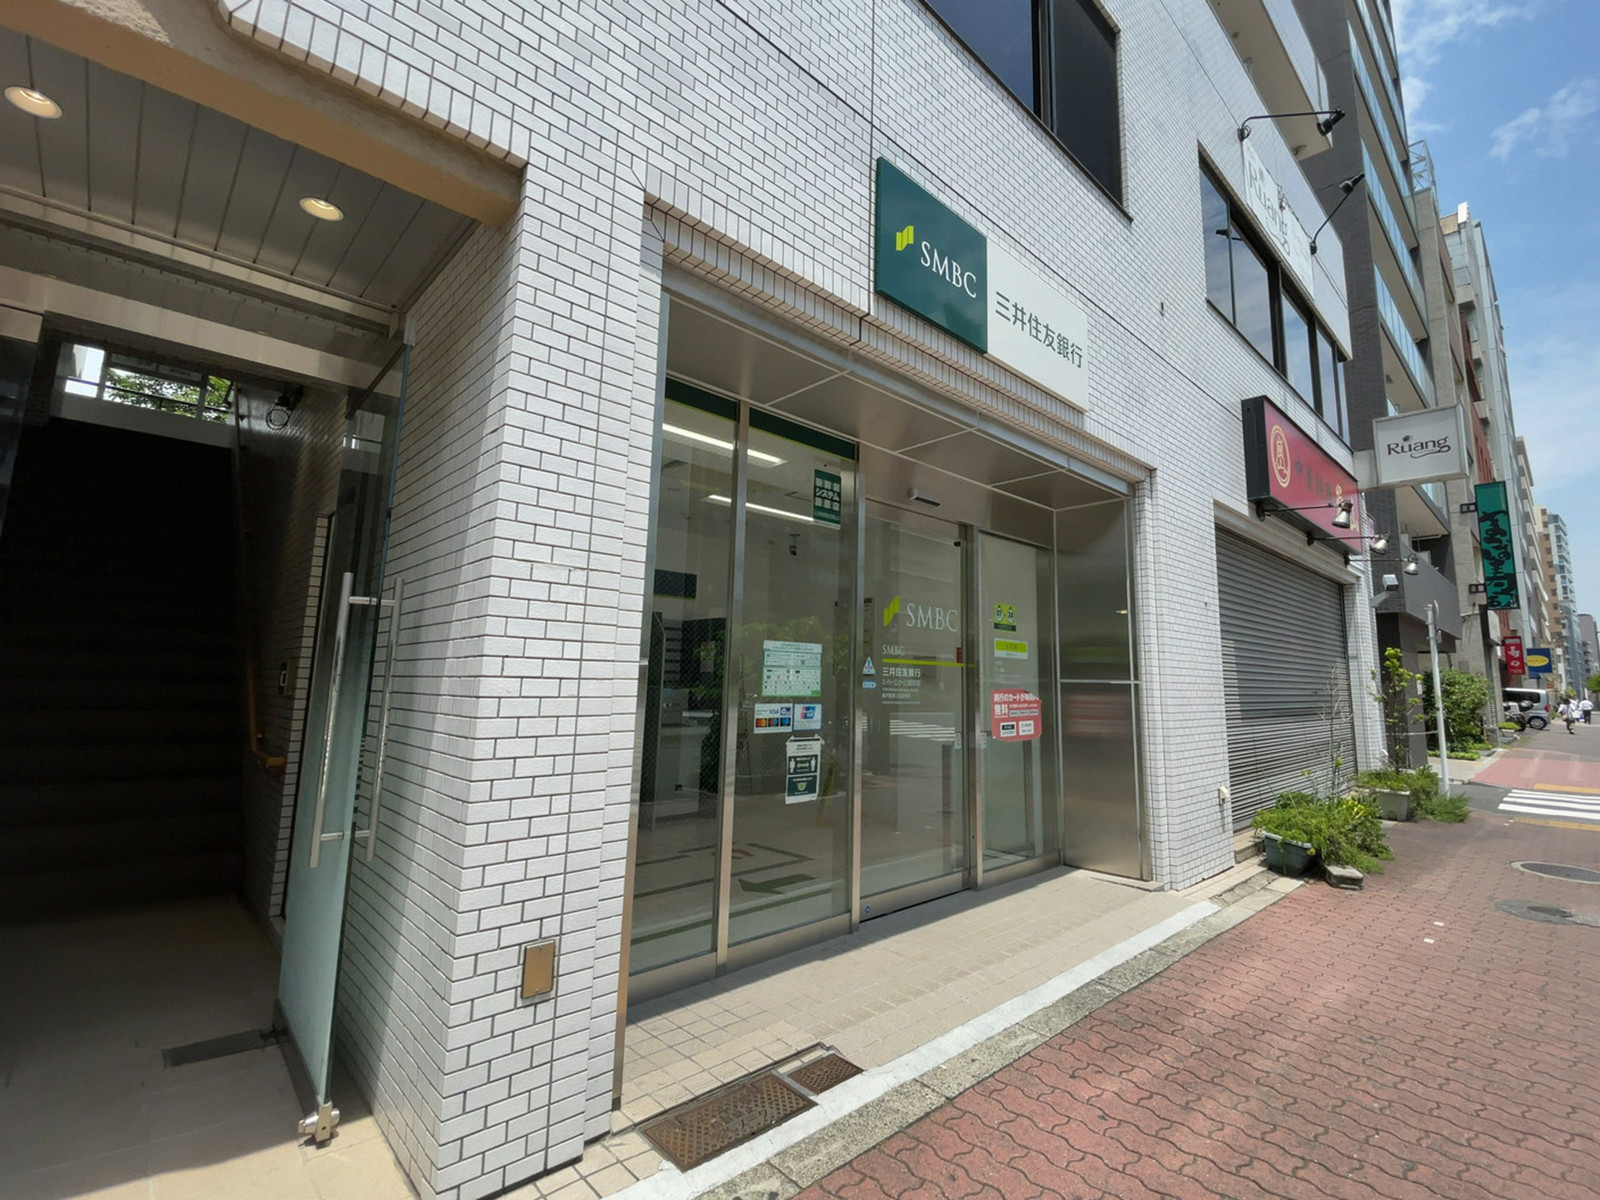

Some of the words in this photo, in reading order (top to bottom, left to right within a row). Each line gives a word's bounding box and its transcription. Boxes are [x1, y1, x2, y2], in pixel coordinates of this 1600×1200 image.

[920, 240, 977, 299] SMBC
[995, 290, 1083, 369] 三井住友銀行
[1386, 435, 1452, 459] Ruang
[906, 603, 958, 632] SMBC
[882, 644, 906, 656] SMBC
[882, 667, 921, 678] 三井住友銀行
